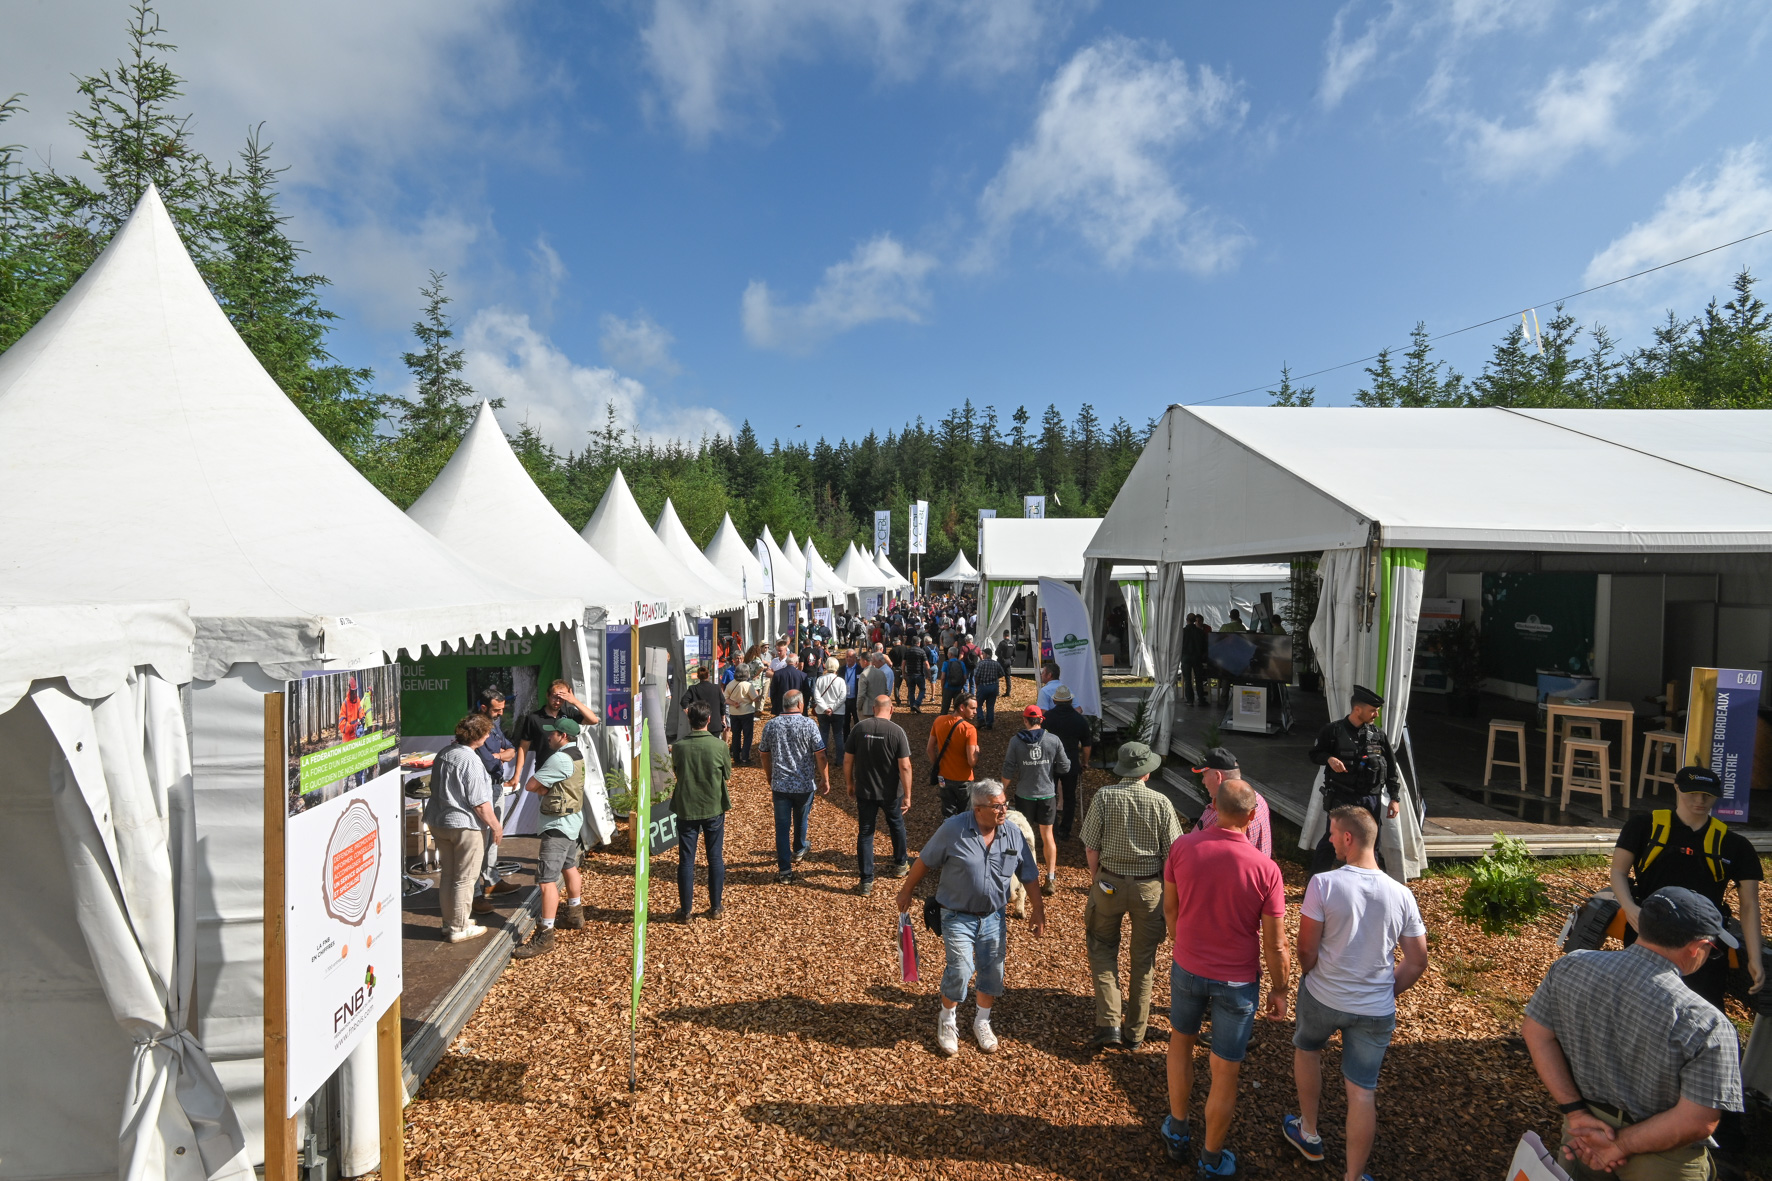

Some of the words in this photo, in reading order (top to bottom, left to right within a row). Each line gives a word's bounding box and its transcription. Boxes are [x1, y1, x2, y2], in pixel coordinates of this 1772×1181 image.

[878, 515, 887, 540] CFBL
[641, 602, 668, 622] FRANSYLVA
[401, 665, 426, 677] QUE
[1737, 673, 1744, 684] G
[1745, 673, 1758, 685] 40
[1716, 692, 1730, 740] BORDEAUX
[301, 758, 310, 767] LA
[310, 748, 342, 764] FÉDÉRATION
[342, 739, 366, 753] NATIONALE
[365, 736, 372, 745] DU
[372, 733, 381, 742] BOIS
[301, 770, 310, 780] LA
[310, 763, 328, 777] FORCE
[329, 760, 340, 770] D'UN
[340, 753, 357, 766] RÉSEAU
[357, 749, 369, 760] POUR
[301, 782, 309, 792] LE
[309, 771, 337, 789] QUOTIDIEN
[337, 769, 344, 778] DE
[344, 764, 354, 776] NOS
[1723, 753, 1738, 799] INDUSTRIE
[311, 954, 317, 963] EN
[317, 940, 335, 958] CHIFFRES
[316, 943, 322, 951] LA
[322, 937, 331, 946] FNB
[334, 986, 364, 1034] FNB
[334, 1004, 374, 1050] www.fnbois.com
